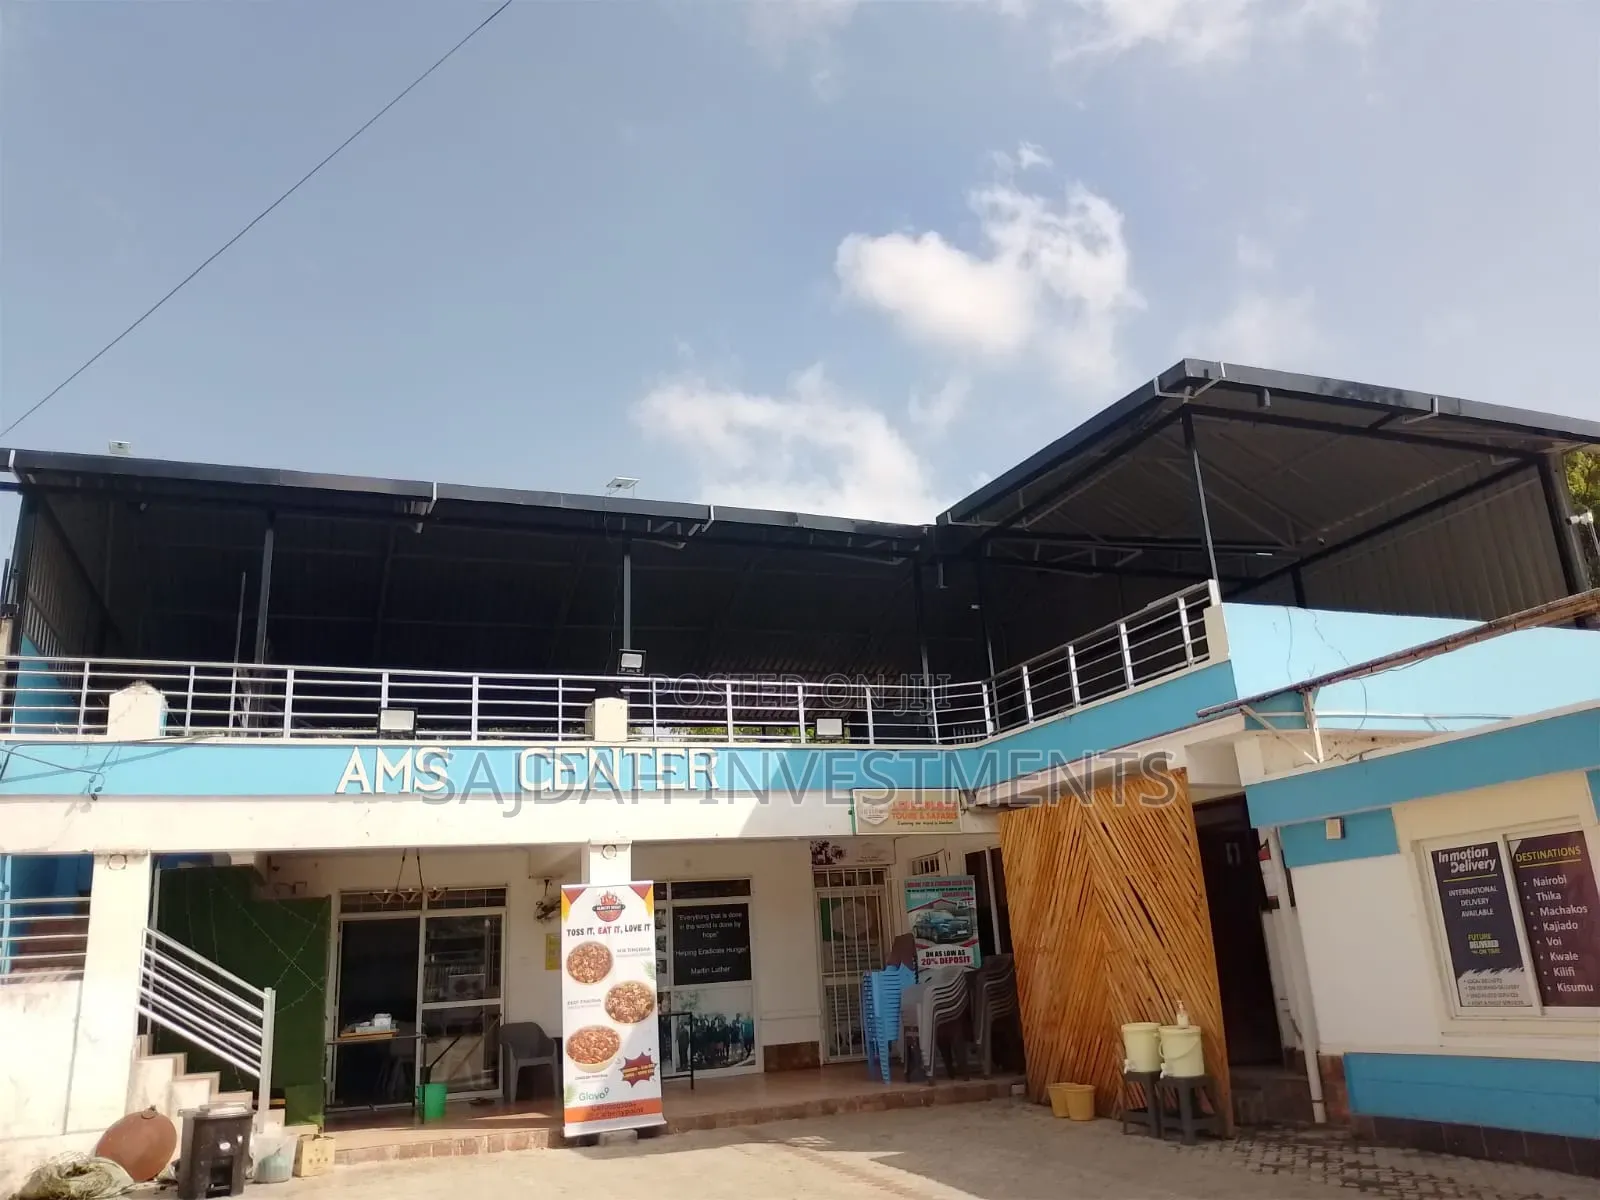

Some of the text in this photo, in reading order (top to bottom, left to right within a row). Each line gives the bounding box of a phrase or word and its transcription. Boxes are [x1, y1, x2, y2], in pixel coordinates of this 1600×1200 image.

[335, 746, 719, 794] AMS CENTER
[1515, 845, 1581, 863] DESTINATIONS
[1450, 859, 1497, 874] Delivery
[1532, 874, 1567, 887] Nairobi
[1448, 885, 1498, 897] INTERNATIONAL
[1535, 891, 1562, 902] Thika
[1460, 898, 1489, 907] DELIVERY
[1461, 908, 1495, 918] AVAILABLE
[1539, 904, 1588, 916] Machakos
[566, 928, 585, 937] TOSS
[597, 926, 611, 935] EAT
[624, 924, 642, 933] LOVE
[644, 923, 651, 932] IT
[1542, 920, 1578, 933] Kajiado
[1545, 936, 1562, 947] Voi
[943, 949, 957, 957] LOW
[1549, 951, 1579, 962] Kwale
[939, 955, 971, 965] DEPOSIT
[1553, 966, 1576, 977] Kilifi
[1556, 982, 1594, 993] Kisumu
[579, 1089, 605, 1101] Glovo
